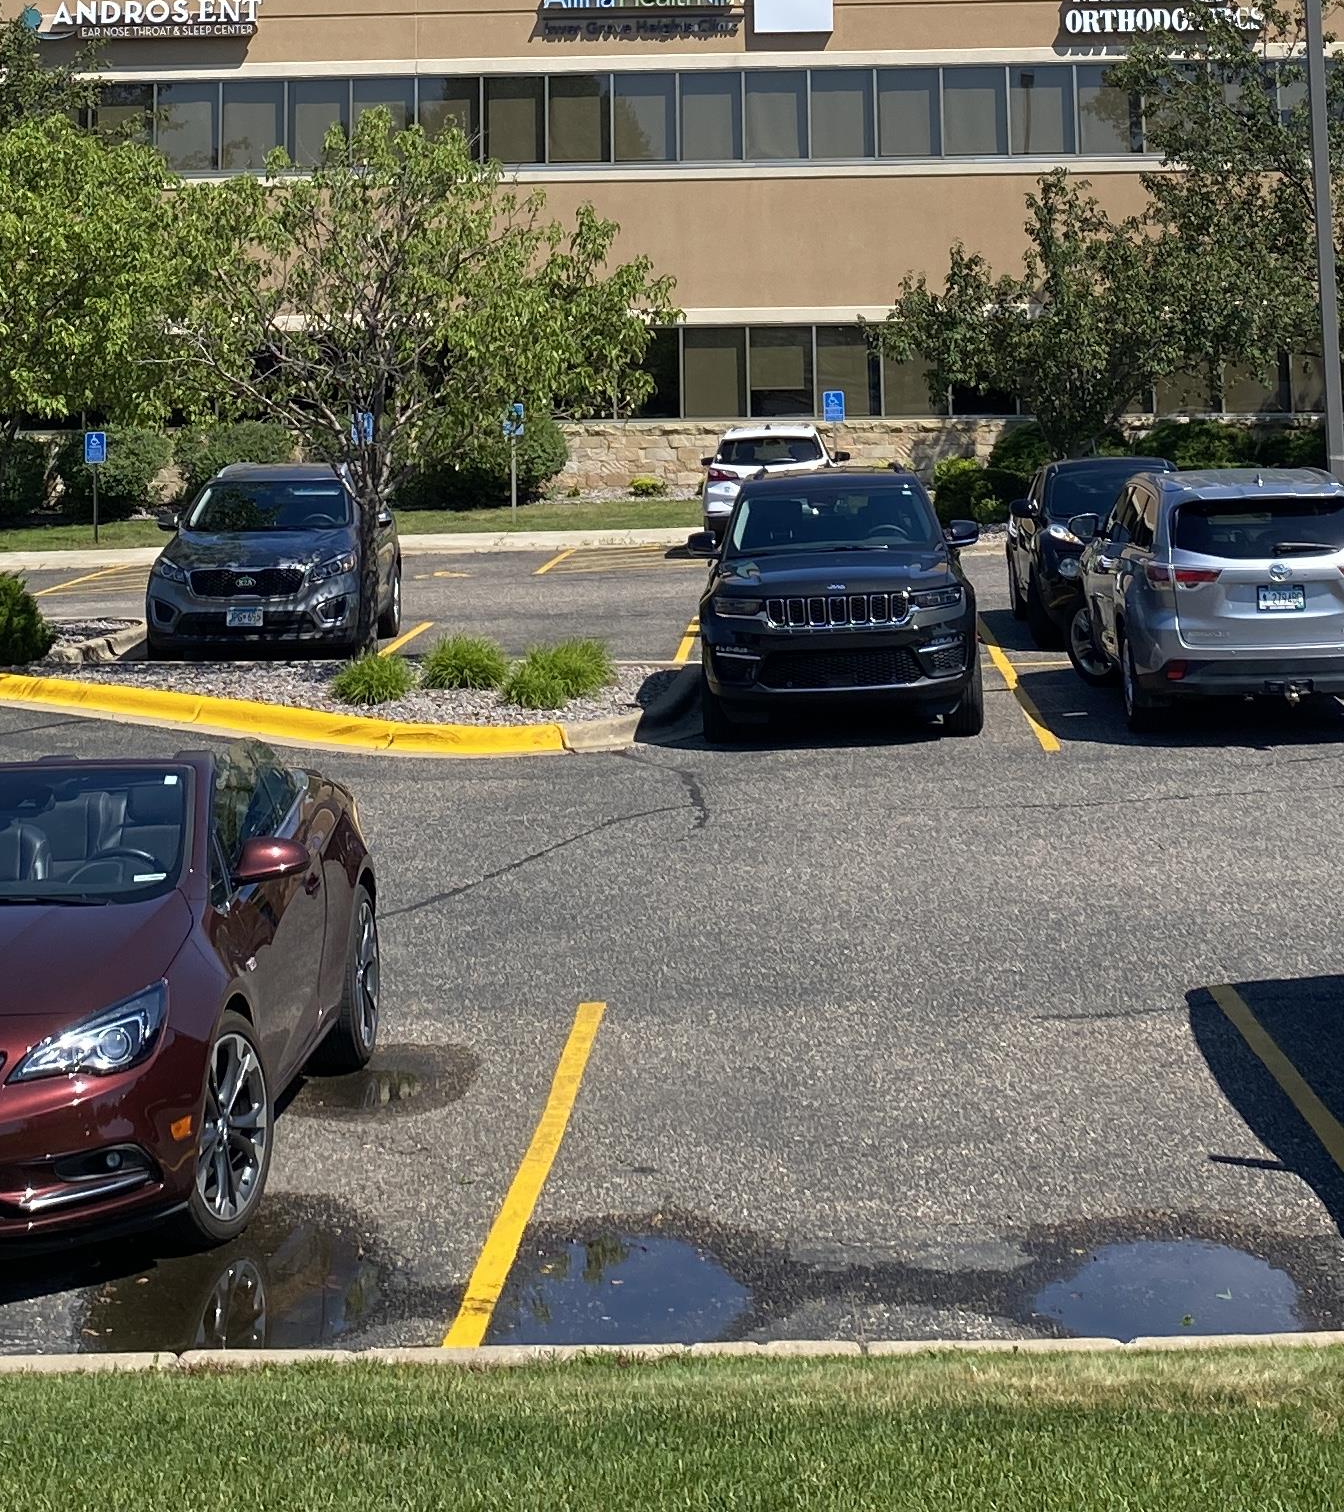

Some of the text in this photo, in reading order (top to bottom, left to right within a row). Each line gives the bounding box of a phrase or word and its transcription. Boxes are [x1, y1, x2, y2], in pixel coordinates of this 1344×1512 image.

[52, 0, 189, 25] ANDROS
[81, 24, 253, 38] EAR NOSE THROAT & SLEEP CENTER
